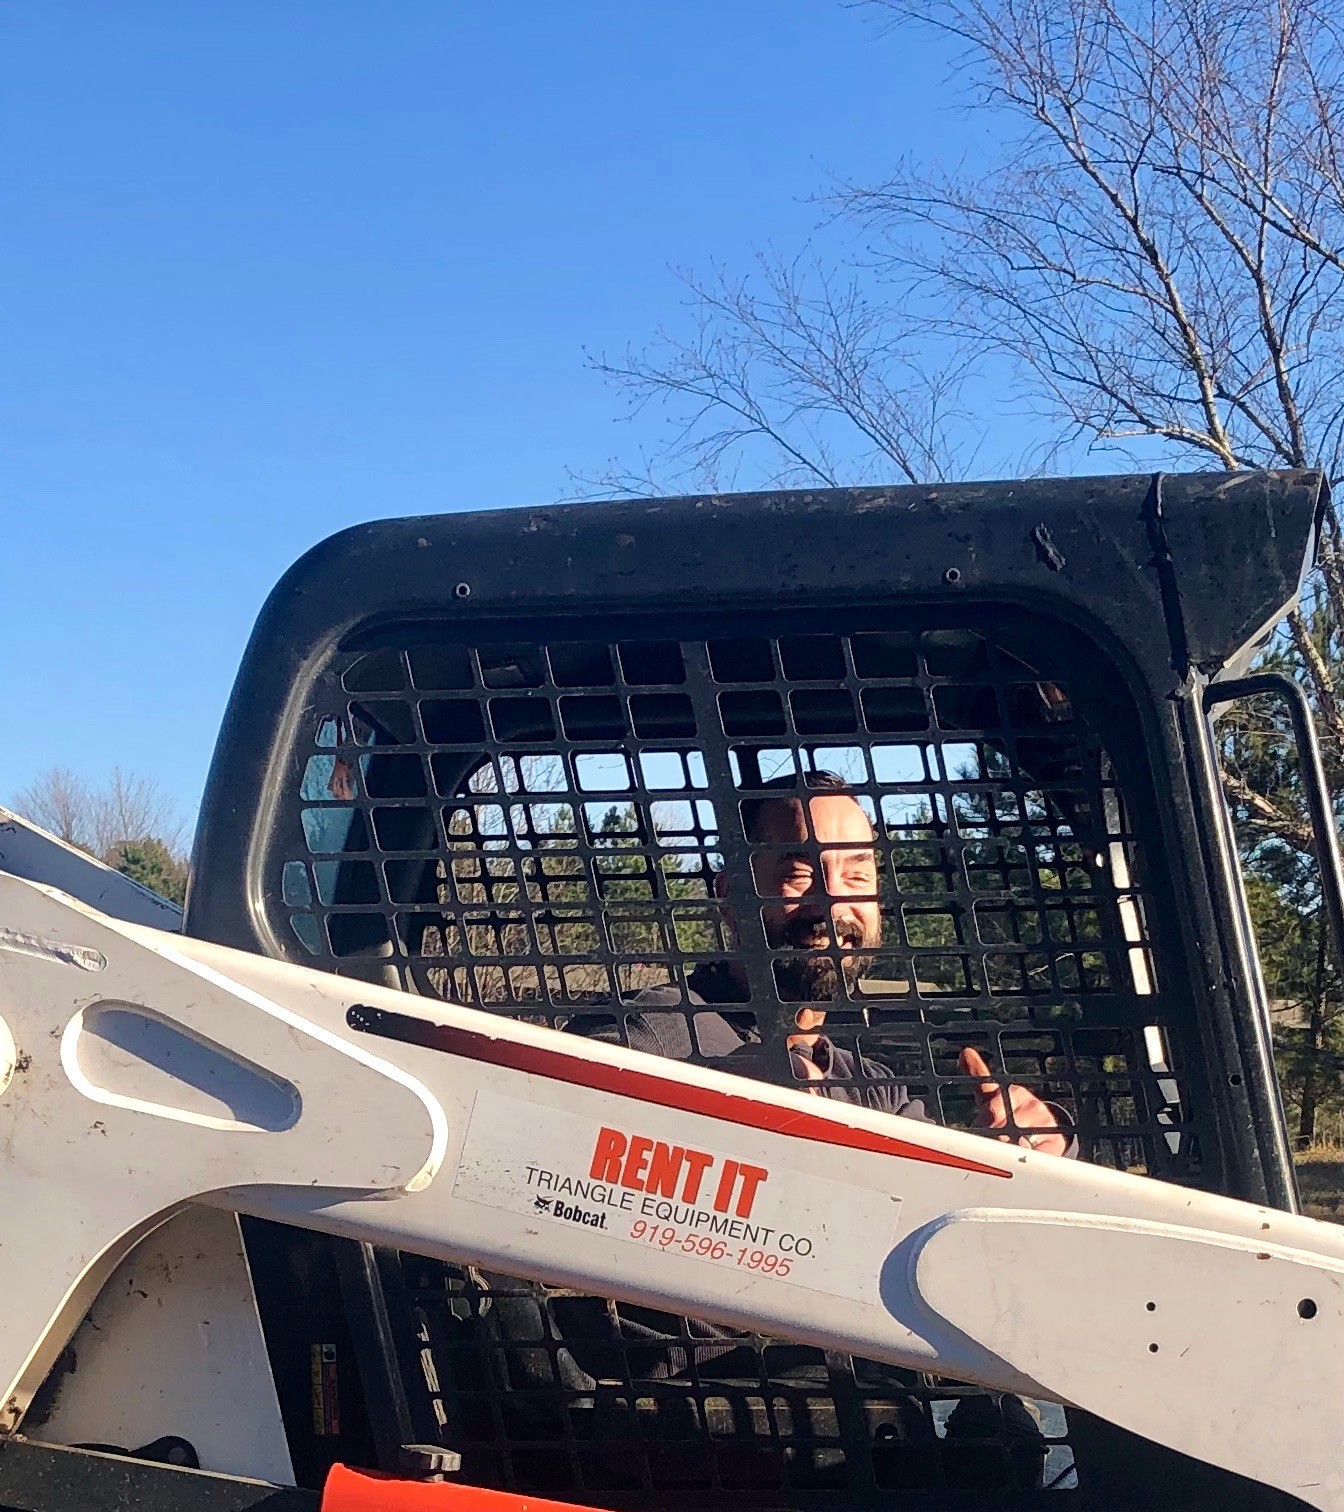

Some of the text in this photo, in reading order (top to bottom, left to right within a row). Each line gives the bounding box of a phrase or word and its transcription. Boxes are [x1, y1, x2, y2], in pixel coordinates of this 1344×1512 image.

[525, 1166, 816, 1258] TRIANGLE EQUIPMENT CO.
[589, 1126, 768, 1219] RENT IT
[630, 1219, 793, 1277] 919-596-1995
